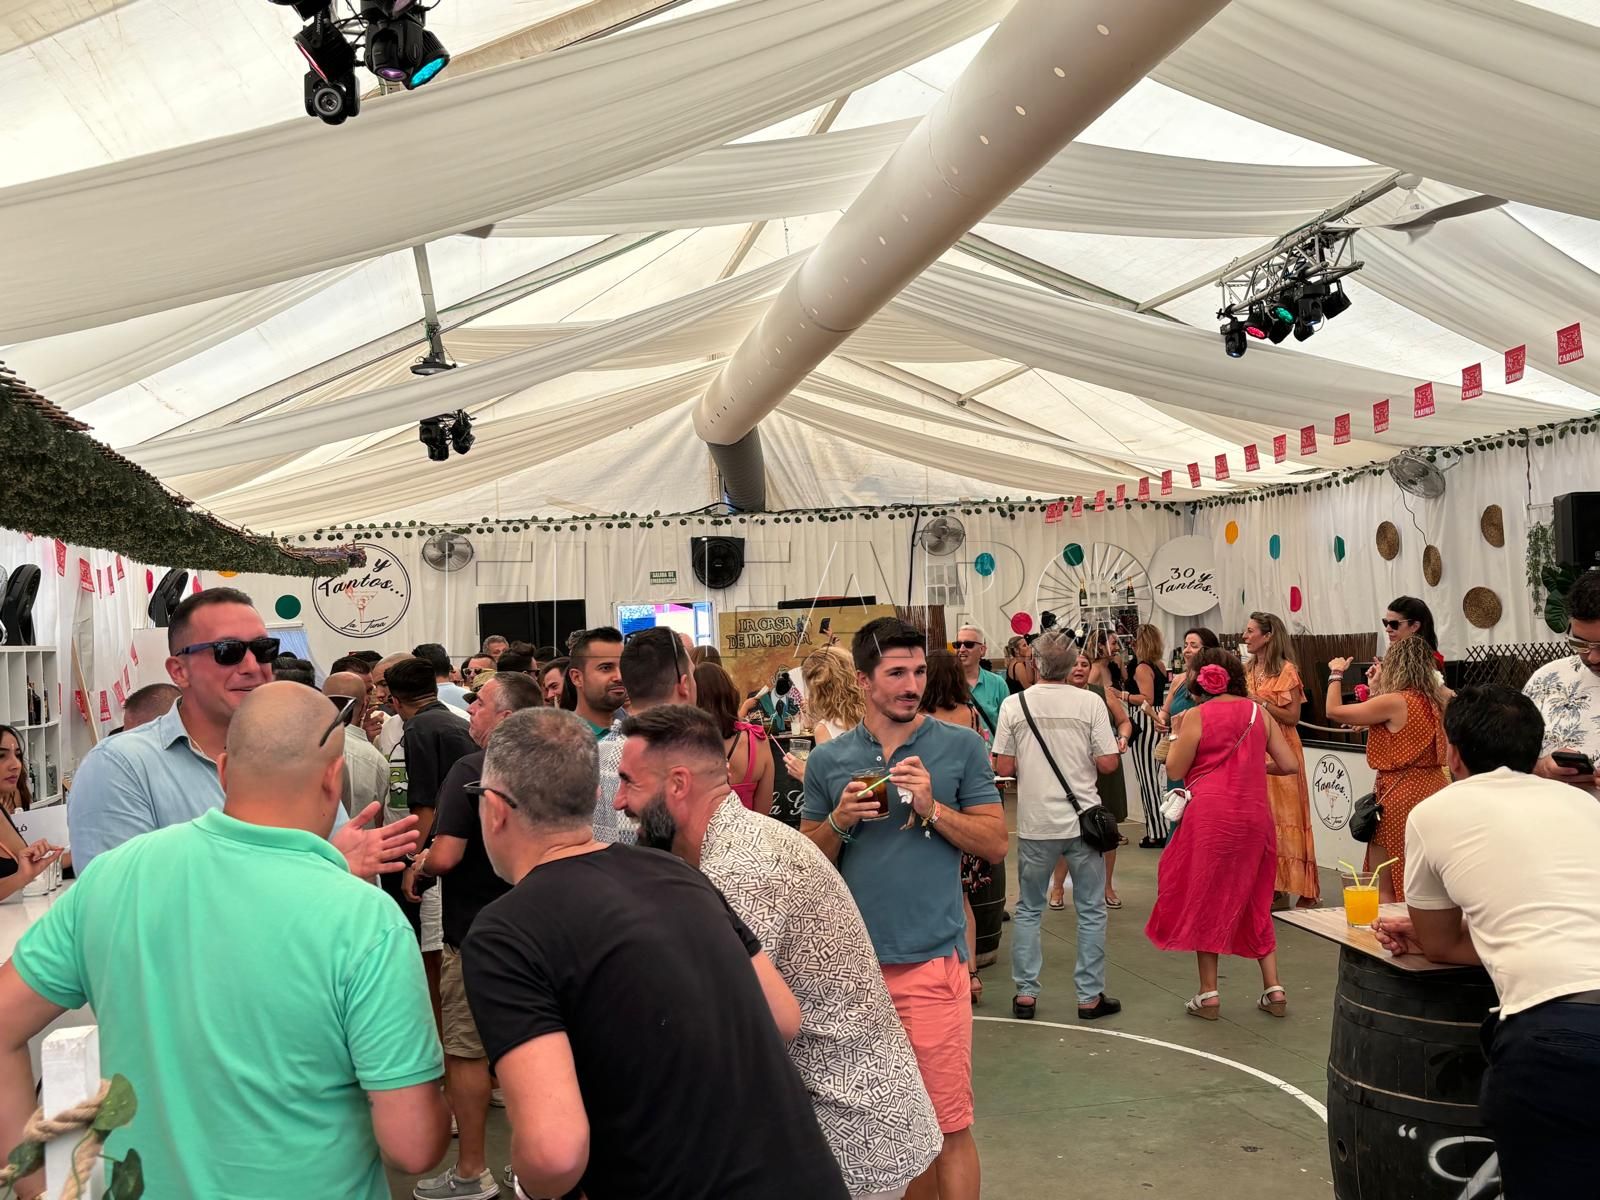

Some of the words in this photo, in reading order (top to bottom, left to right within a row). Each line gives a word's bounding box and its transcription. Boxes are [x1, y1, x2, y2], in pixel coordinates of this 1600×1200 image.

[373, 558, 391, 573] y
[1170, 567, 1195, 580] 30
[1197, 572, 1213, 582] y
[318, 573, 404, 597] Tantos...
[1154, 579, 1219, 599] Tantos...
[340, 618, 360, 632] La
[360, 616, 389, 633] Tuna
[738, 618, 758, 633] LA
[758, 617, 795, 631] CASA
[726, 633, 746, 649] DE
[747, 633, 767, 648] LA
[766, 631, 813, 648] TROYA
[1321, 761, 1335, 774] 30
[1336, 769, 1344, 779] y
[1314, 777, 1350, 803] Tantos...
